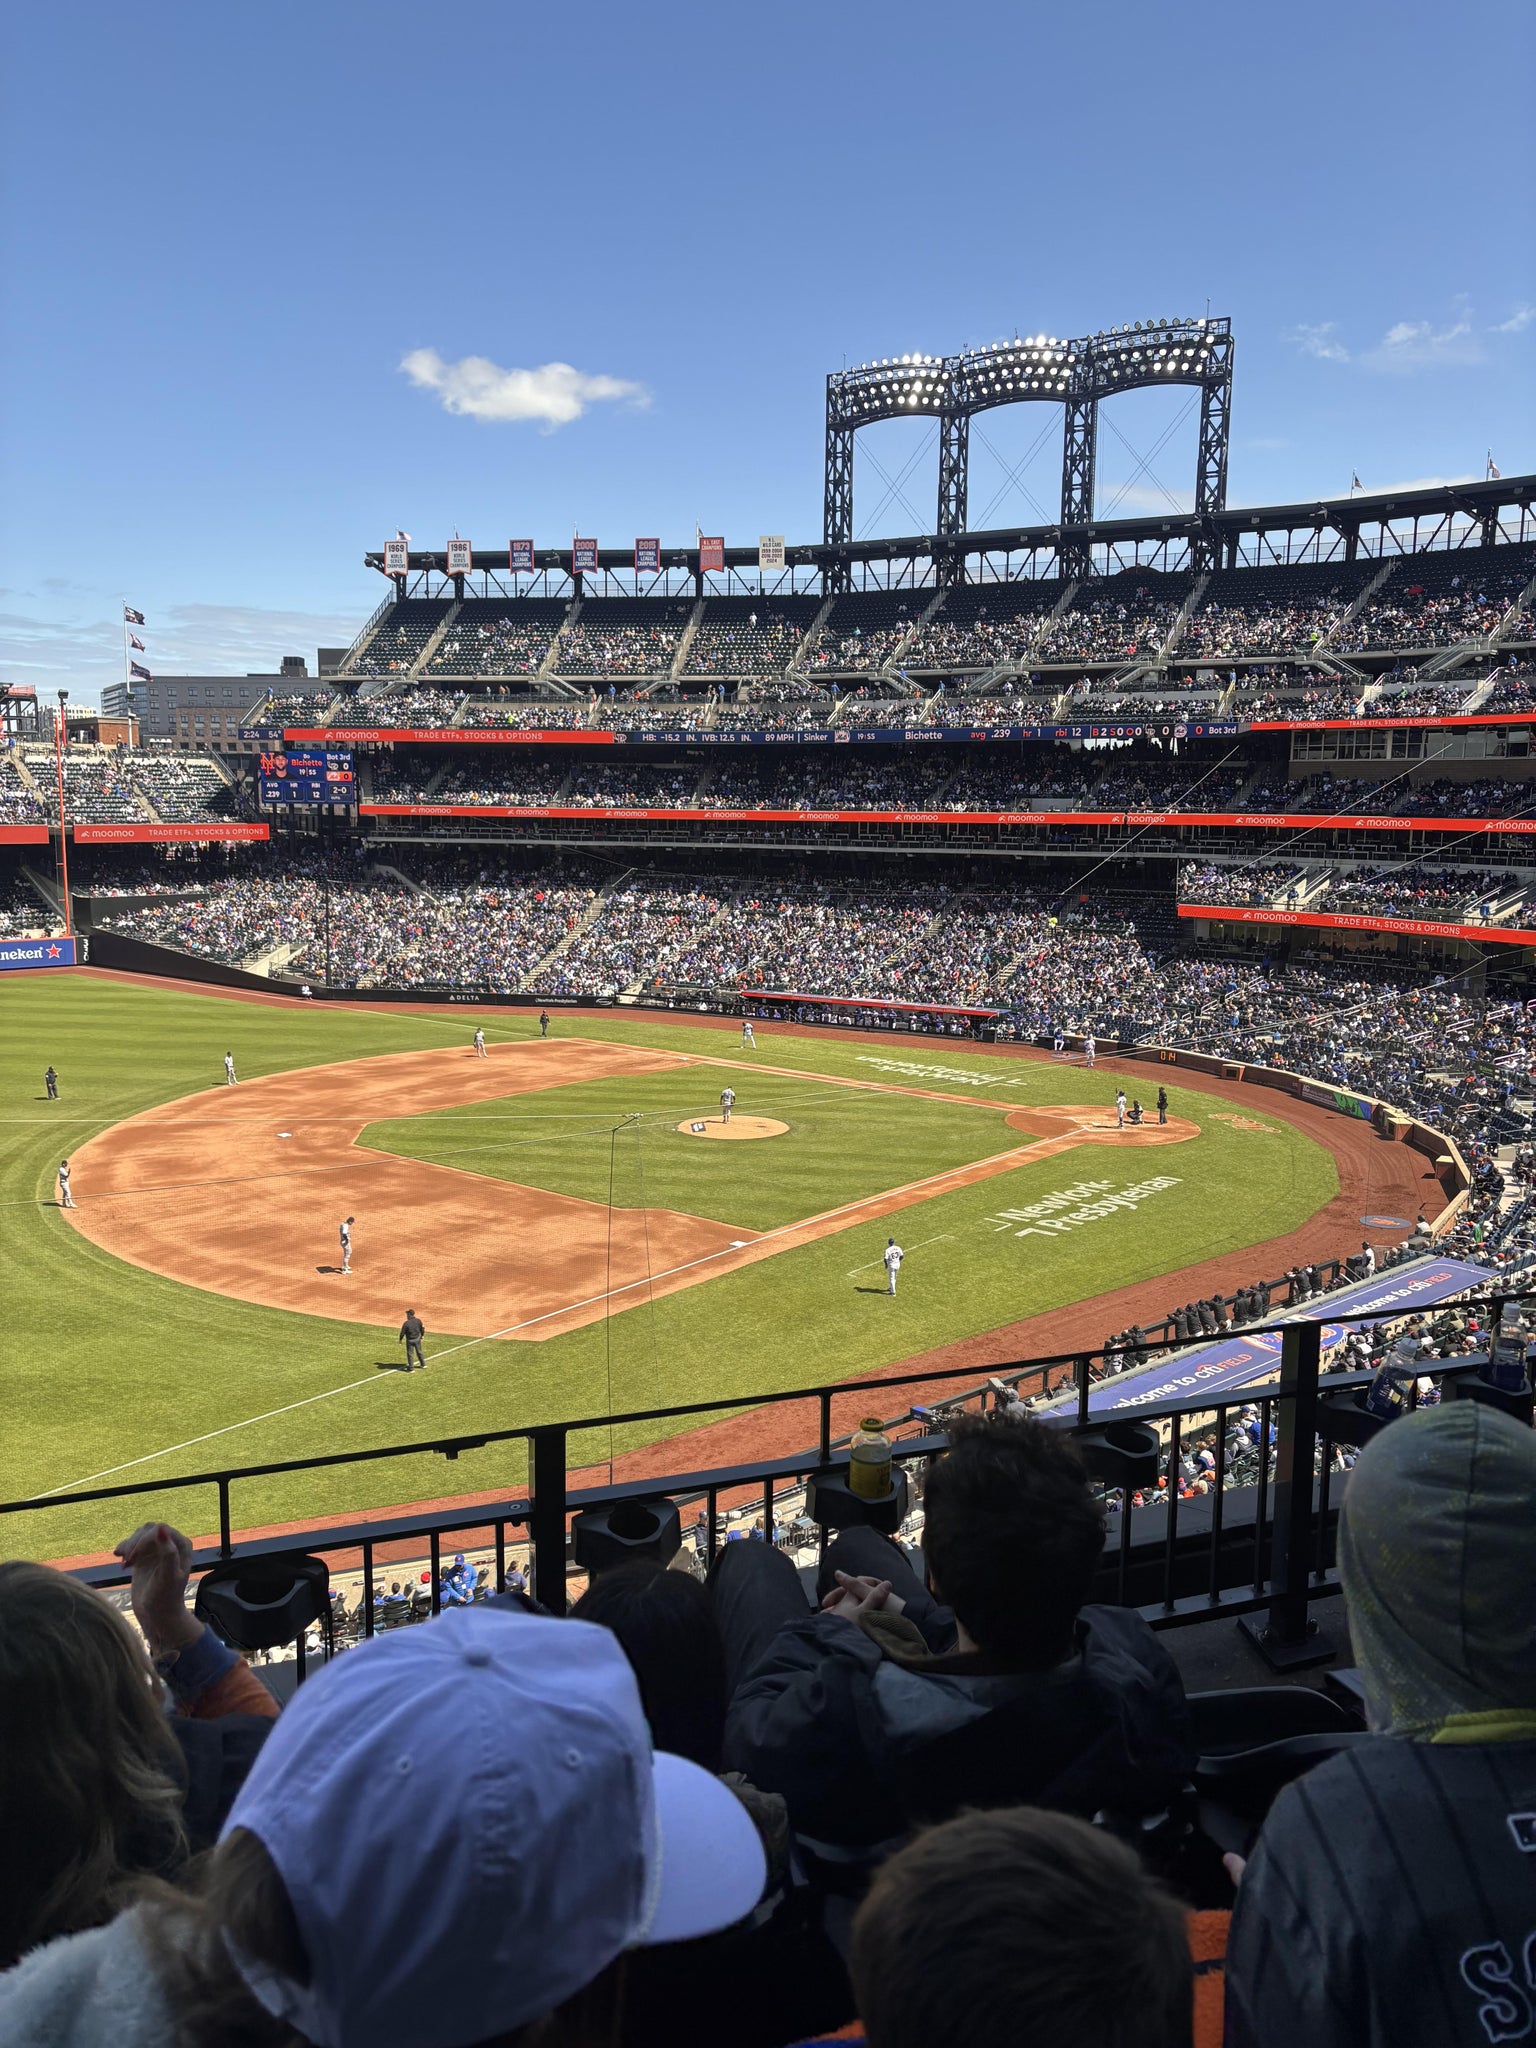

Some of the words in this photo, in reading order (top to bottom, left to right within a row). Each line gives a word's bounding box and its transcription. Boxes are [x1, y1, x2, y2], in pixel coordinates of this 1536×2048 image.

[388, 544, 405, 552] 1969
[451, 544, 468, 552] 1986
[576, 541, 595, 550] 2000
[1092, 728, 1099, 736] B
[1101, 728, 1107, 736] 2
[1110, 728, 1116, 736] S
[1162, 726, 1170, 735] 0
[1195, 726, 1203, 735] 0
[1209, 724, 1223, 734] Bot
[1223, 724, 1236, 733] 3rd
[442, 732, 462, 740] ETFs,
[506, 732, 542, 740] OPTIONS
[905, 731, 942, 740] Bichette
[970, 732, 986, 741] avg
[991, 729, 1011, 738] .239
[1022, 729, 1032, 737] hr
[1037, 728, 1040, 736] 1
[1055, 728, 1067, 736] rbi
[1072, 728, 1081, 736] 12
[1366, 819, 1411, 827] moomoo
[1254, 913, 1298, 922] moomoo
[1333, 917, 1361, 925] TRADE
[1384, 921, 1415, 931] STOCKS
[1424, 925, 1460, 935] OPTIONS
[1035, 1176, 1184, 1231] Presbyterian
[1391, 1289, 1412, 1297] to
[1173, 1376, 1197, 1387] to
[1459, 1933, 1536, 2044] S
